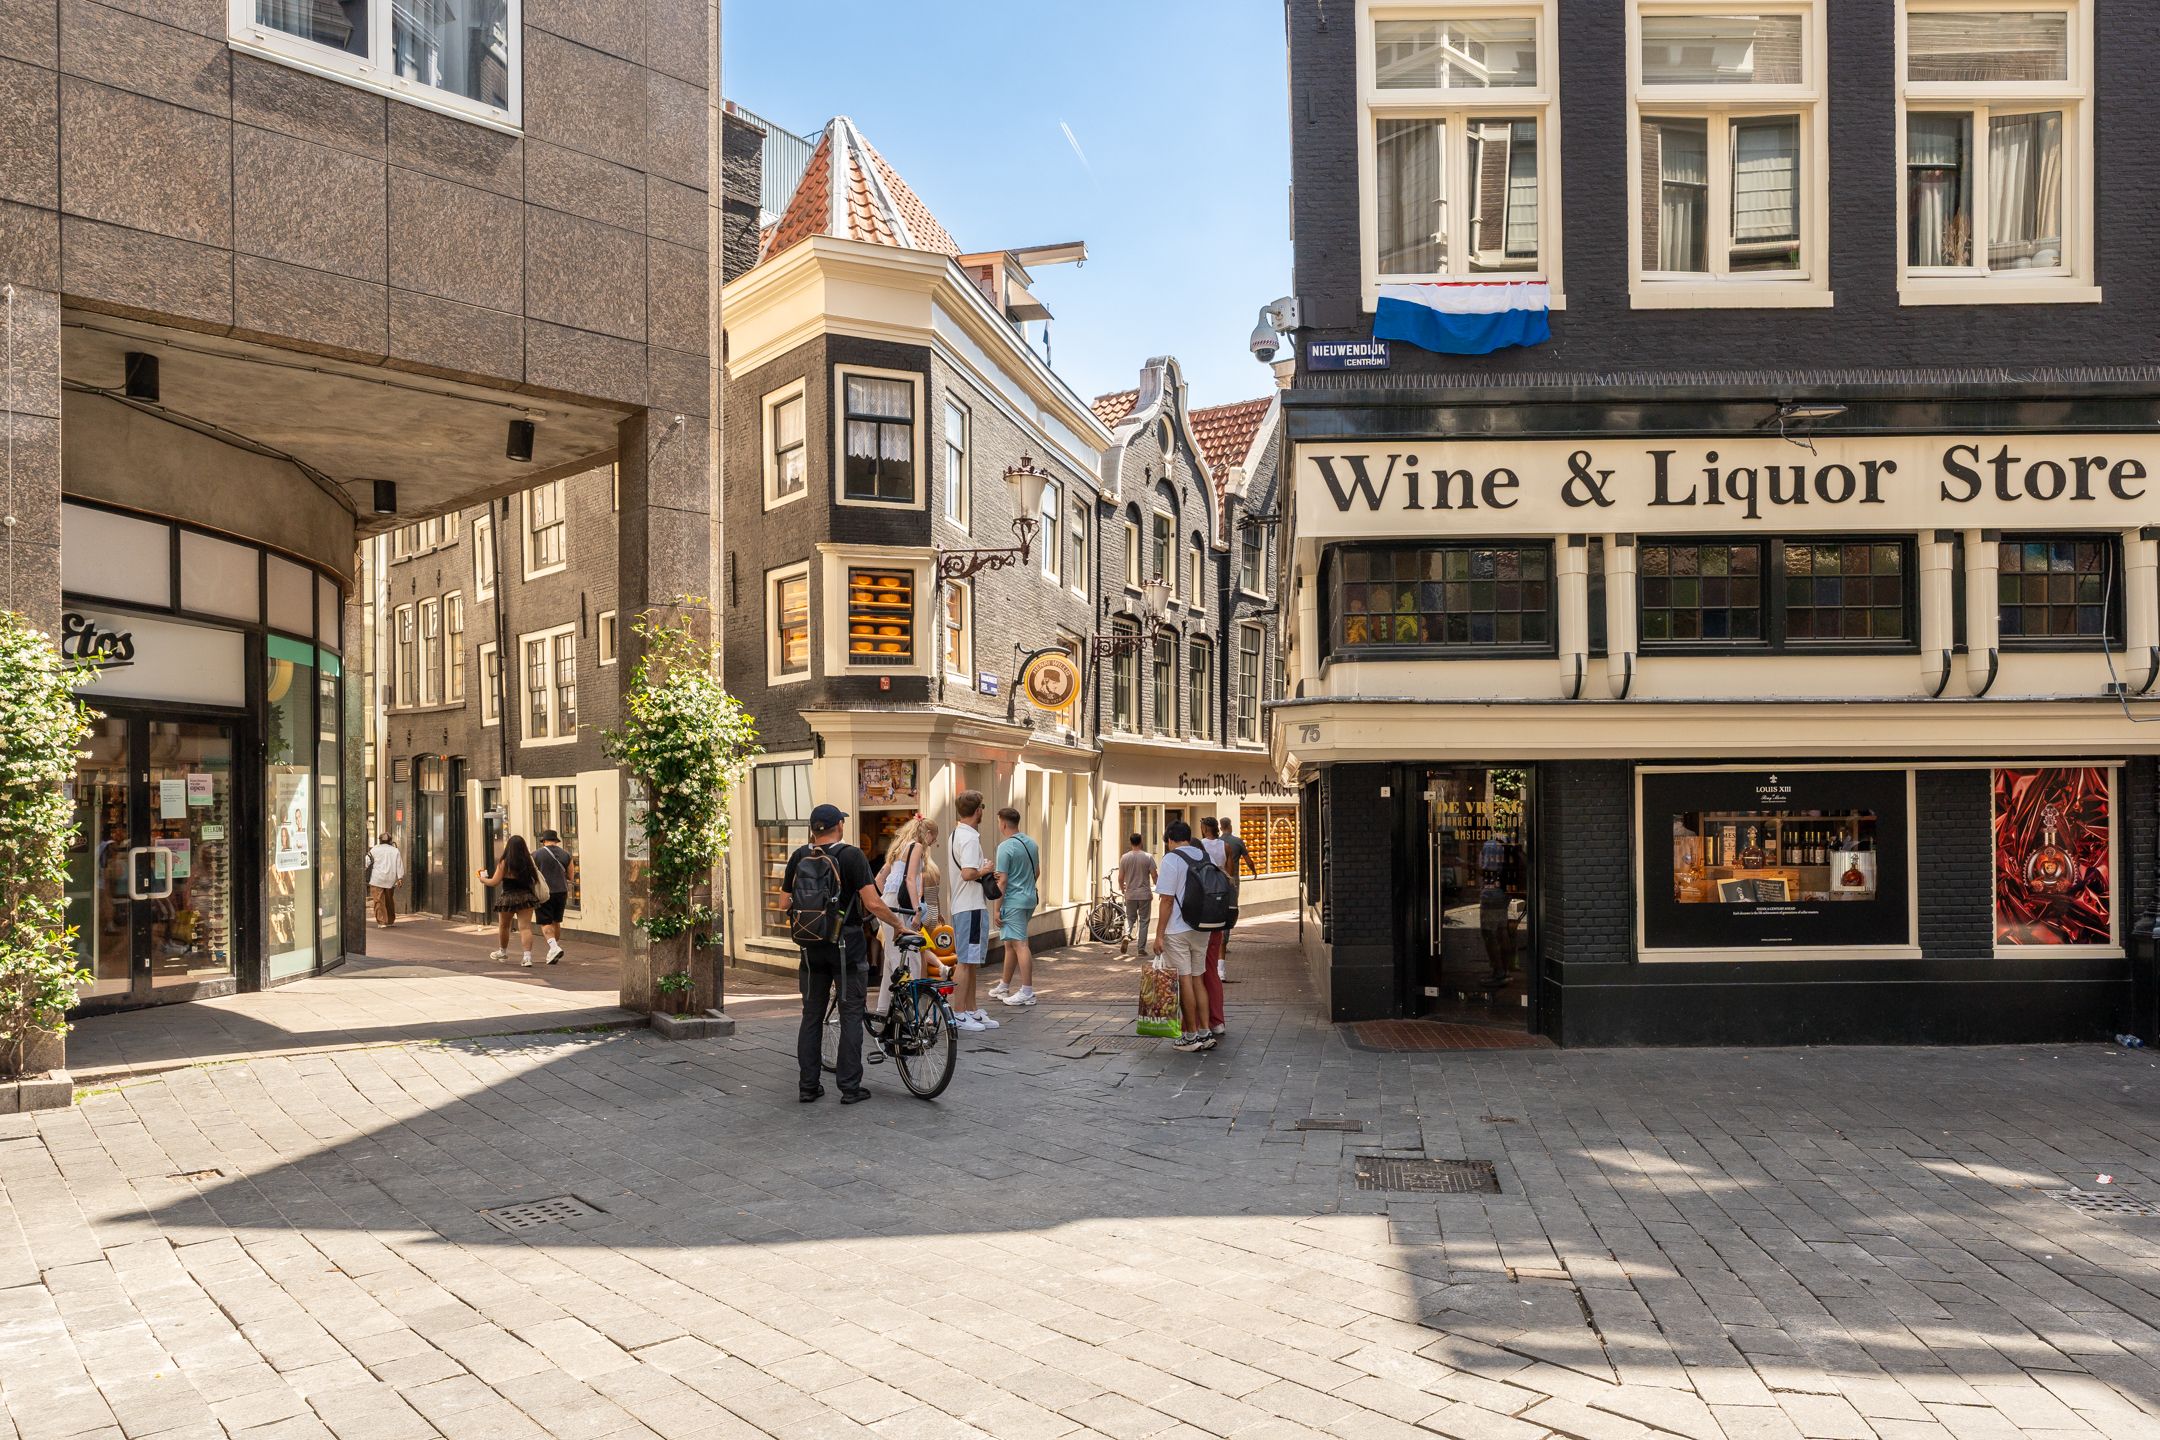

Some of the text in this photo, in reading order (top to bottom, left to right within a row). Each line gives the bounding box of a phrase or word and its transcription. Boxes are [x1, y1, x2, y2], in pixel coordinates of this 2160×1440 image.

[1312, 343, 1386, 357] NIEUWENDIJK
[1344, 358, 1386, 367] (CENTRUM)
[1308, 443, 2147, 520] Wine & Liquor Store
[61, 612, 135, 661] Etos
[1299, 723, 1320, 744] 75
[1178, 771, 1210, 796] Henri
[1213, 772, 1247, 800] Willig
[1436, 801, 1460, 814] DE
[1143, 1016, 1169, 1024] PLUS
